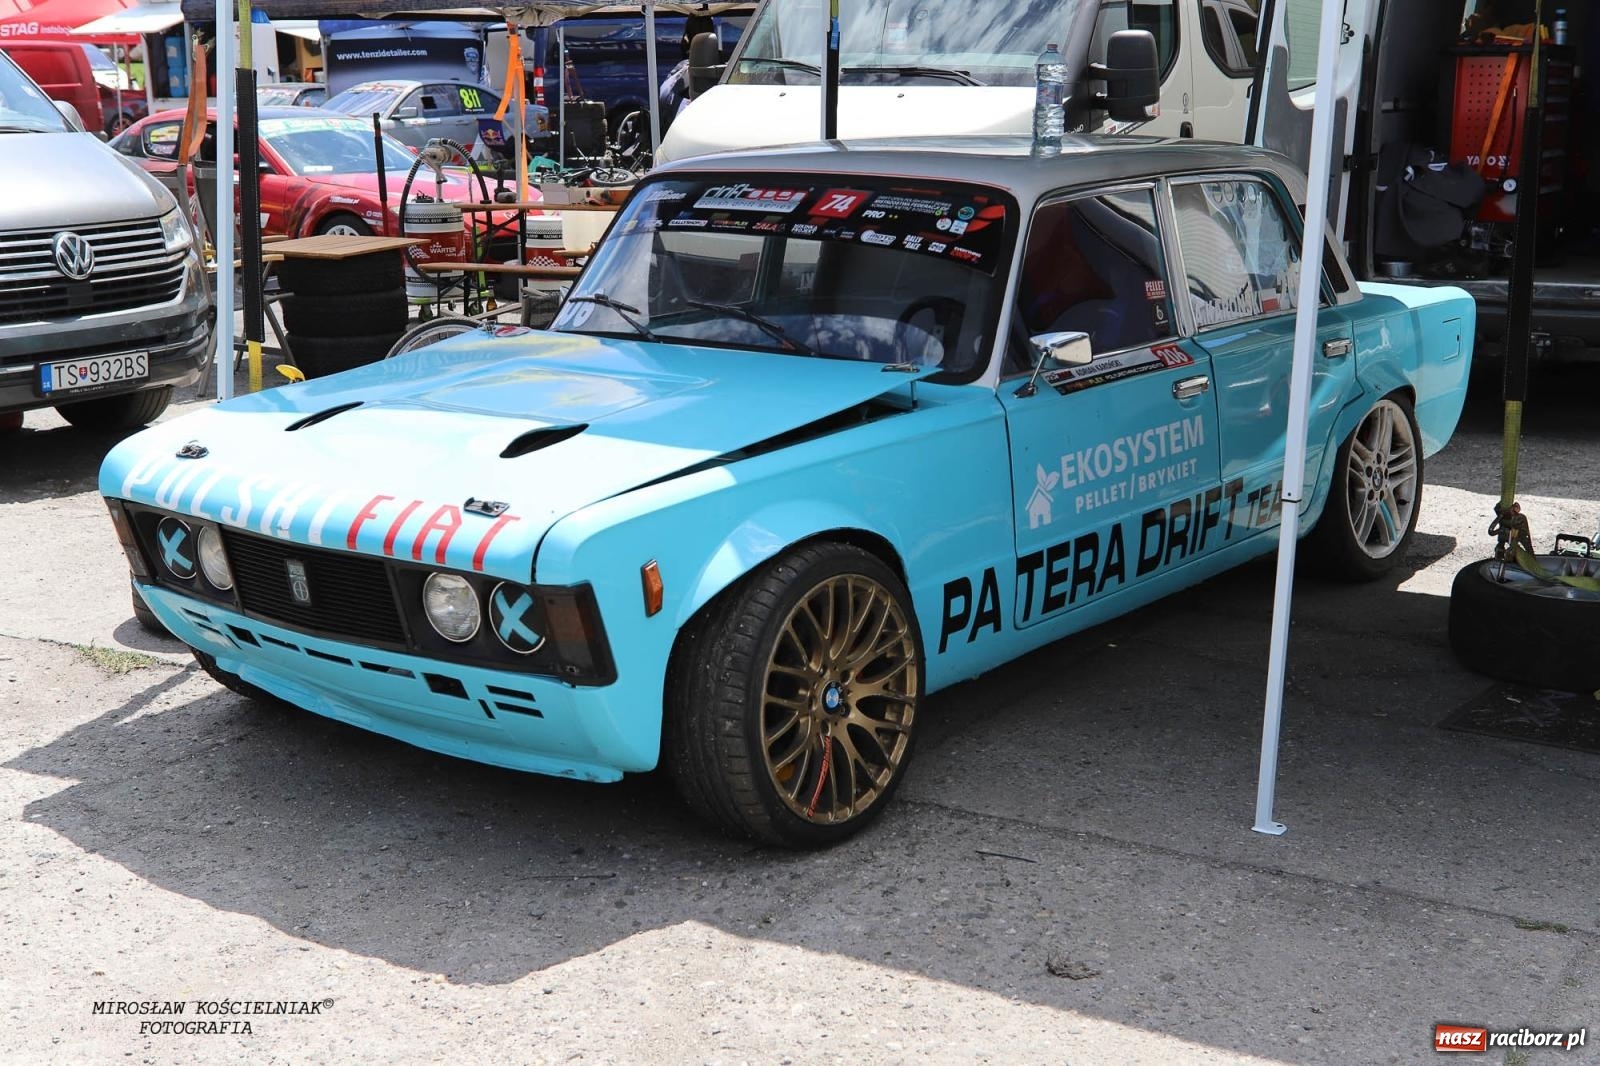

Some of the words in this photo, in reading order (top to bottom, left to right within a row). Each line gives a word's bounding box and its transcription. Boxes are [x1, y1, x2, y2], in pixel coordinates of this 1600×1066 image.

[0, 21, 39, 37] STAG
[336, 48, 428, 61] www.tenzidetailer.com
[459, 87, 482, 109] 811
[1466, 155, 1497, 167] YAO
[819, 193, 857, 213] 74
[862, 209, 886, 219] PRO
[1145, 280, 1164, 292] PELLET
[1060, 415, 1205, 490] EKOSYSTEM
[121, 455, 345, 546] POLSKI
[347, 494, 521, 571] FIAT
[1135, 476, 1244, 578] DRIFT
[1247, 479, 1284, 532] TEA
